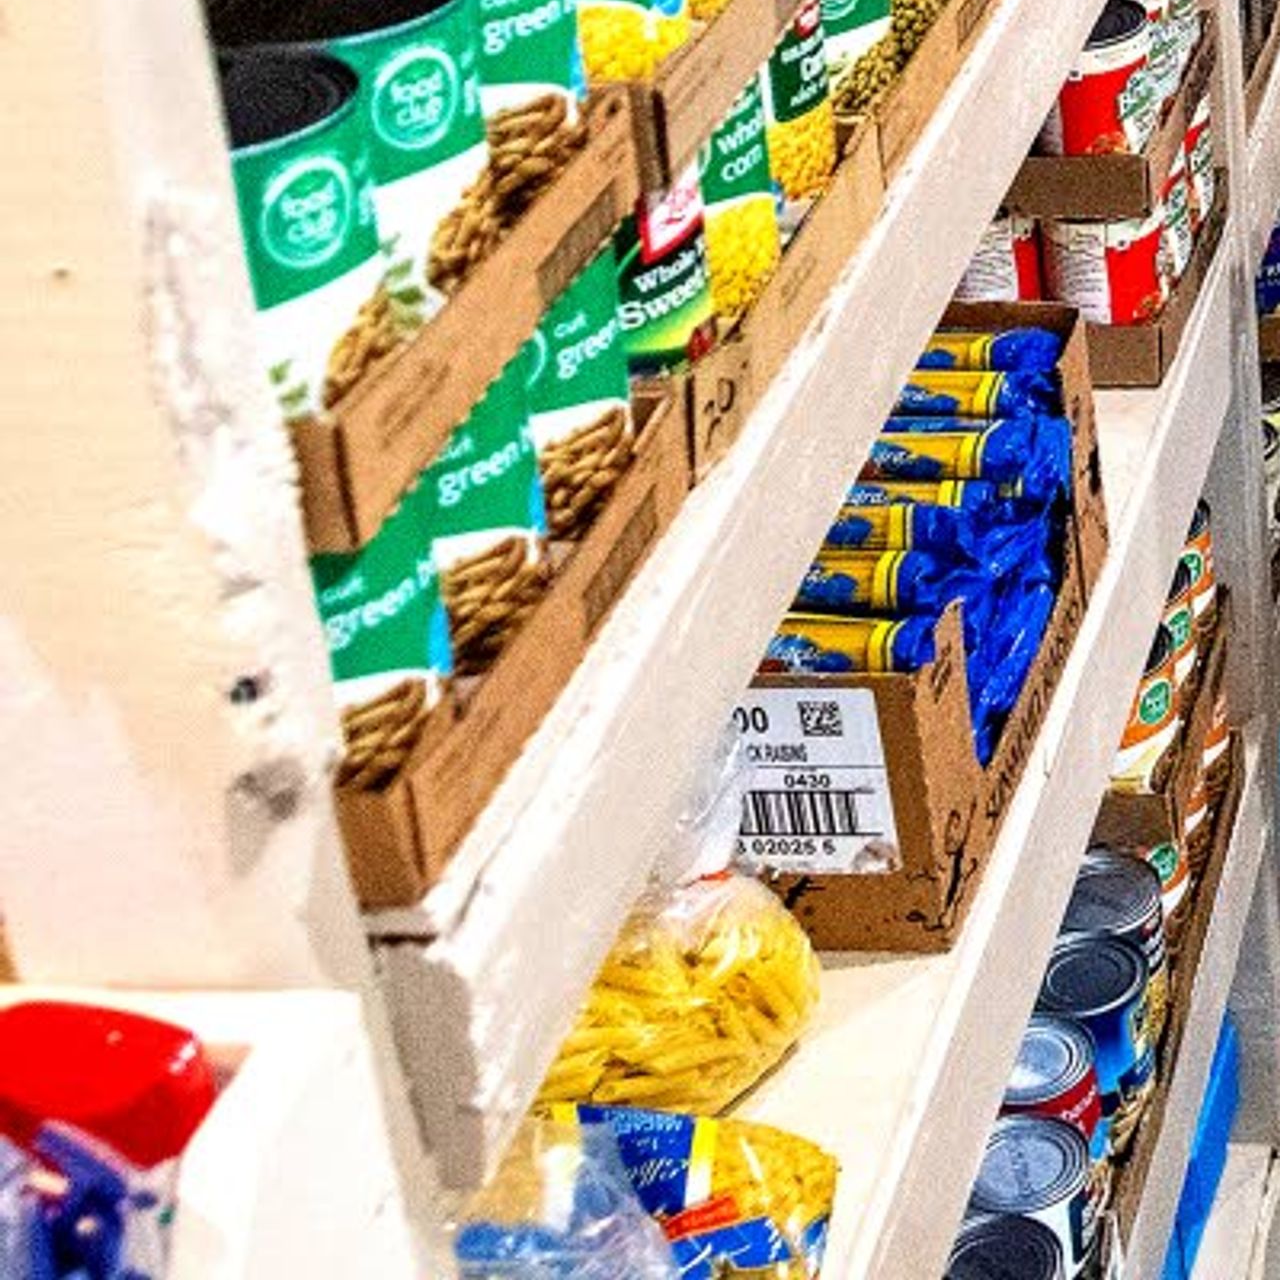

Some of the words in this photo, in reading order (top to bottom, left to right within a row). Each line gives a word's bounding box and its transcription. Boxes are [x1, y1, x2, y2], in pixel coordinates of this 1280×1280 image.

[482, 0, 565, 52] green
[390, 70, 443, 104] food
[397, 98, 443, 132] club
[281, 183, 337, 217] food
[286, 208, 338, 246] club
[554, 313, 588, 339] cut
[437, 447, 516, 507] green
[325, 582, 415, 651] green
[784, 774, 831, 788] 0430
